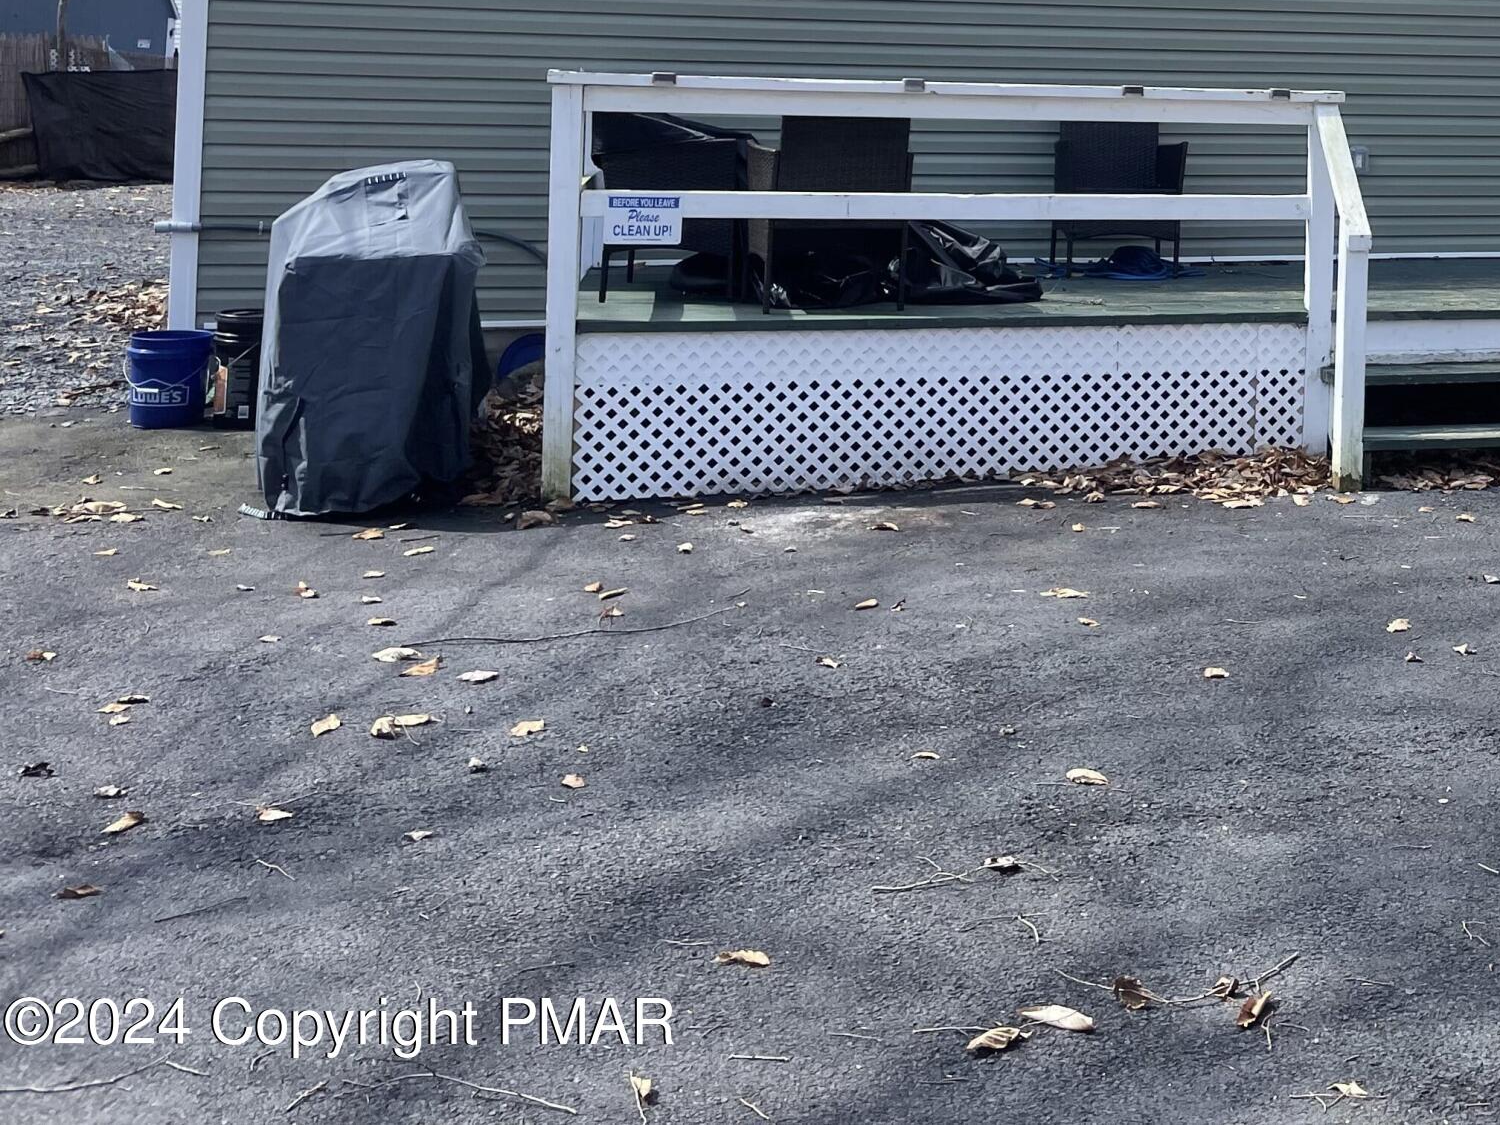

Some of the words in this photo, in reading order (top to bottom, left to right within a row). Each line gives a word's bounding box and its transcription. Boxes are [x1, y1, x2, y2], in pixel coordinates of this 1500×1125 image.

[612, 198, 639, 207] BEFORE
[640, 197, 654, 207] YOU
[655, 198, 676, 208] LEAVE
[627, 208, 660, 223] Please
[612, 224, 651, 236] CLEAN
[653, 225, 672, 236] UP!
